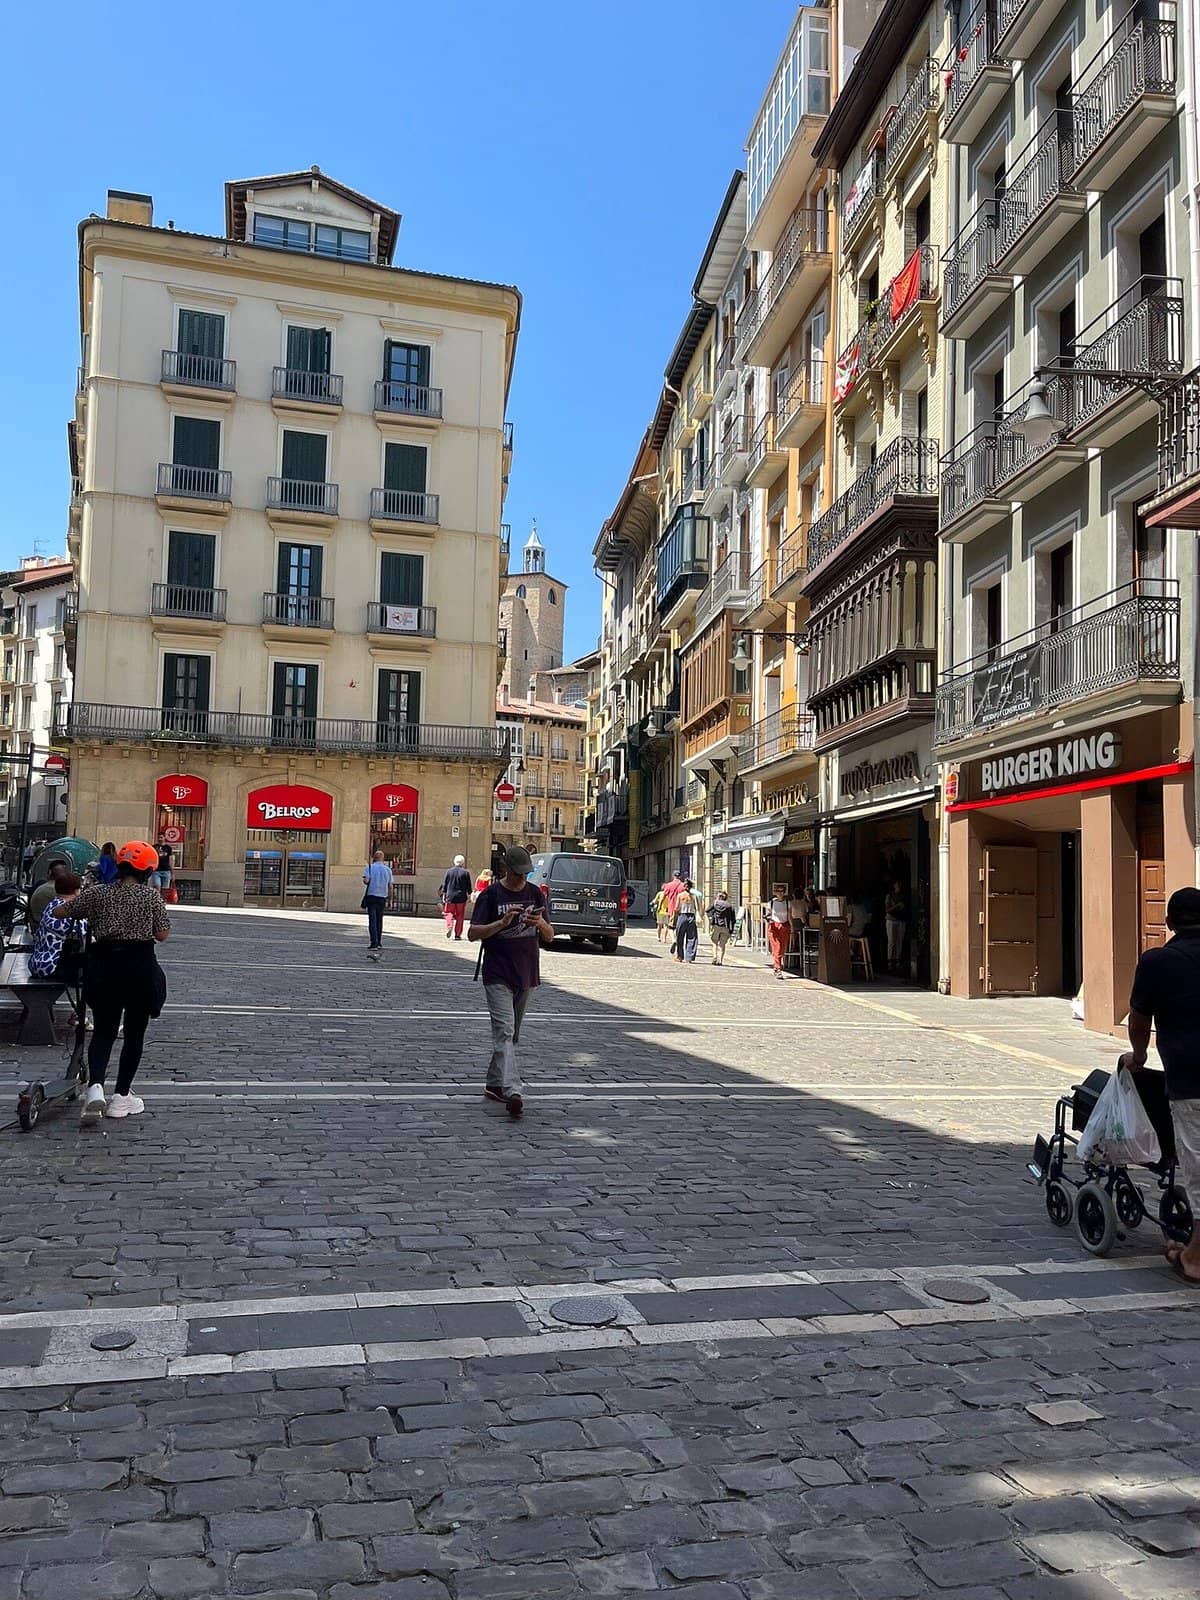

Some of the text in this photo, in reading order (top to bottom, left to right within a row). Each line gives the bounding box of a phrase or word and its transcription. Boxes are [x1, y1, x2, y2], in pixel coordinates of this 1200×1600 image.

[982, 731, 1115, 791] BURGER KING
[258, 802, 312, 820] BELROS
[589, 900, 618, 909] amazon
